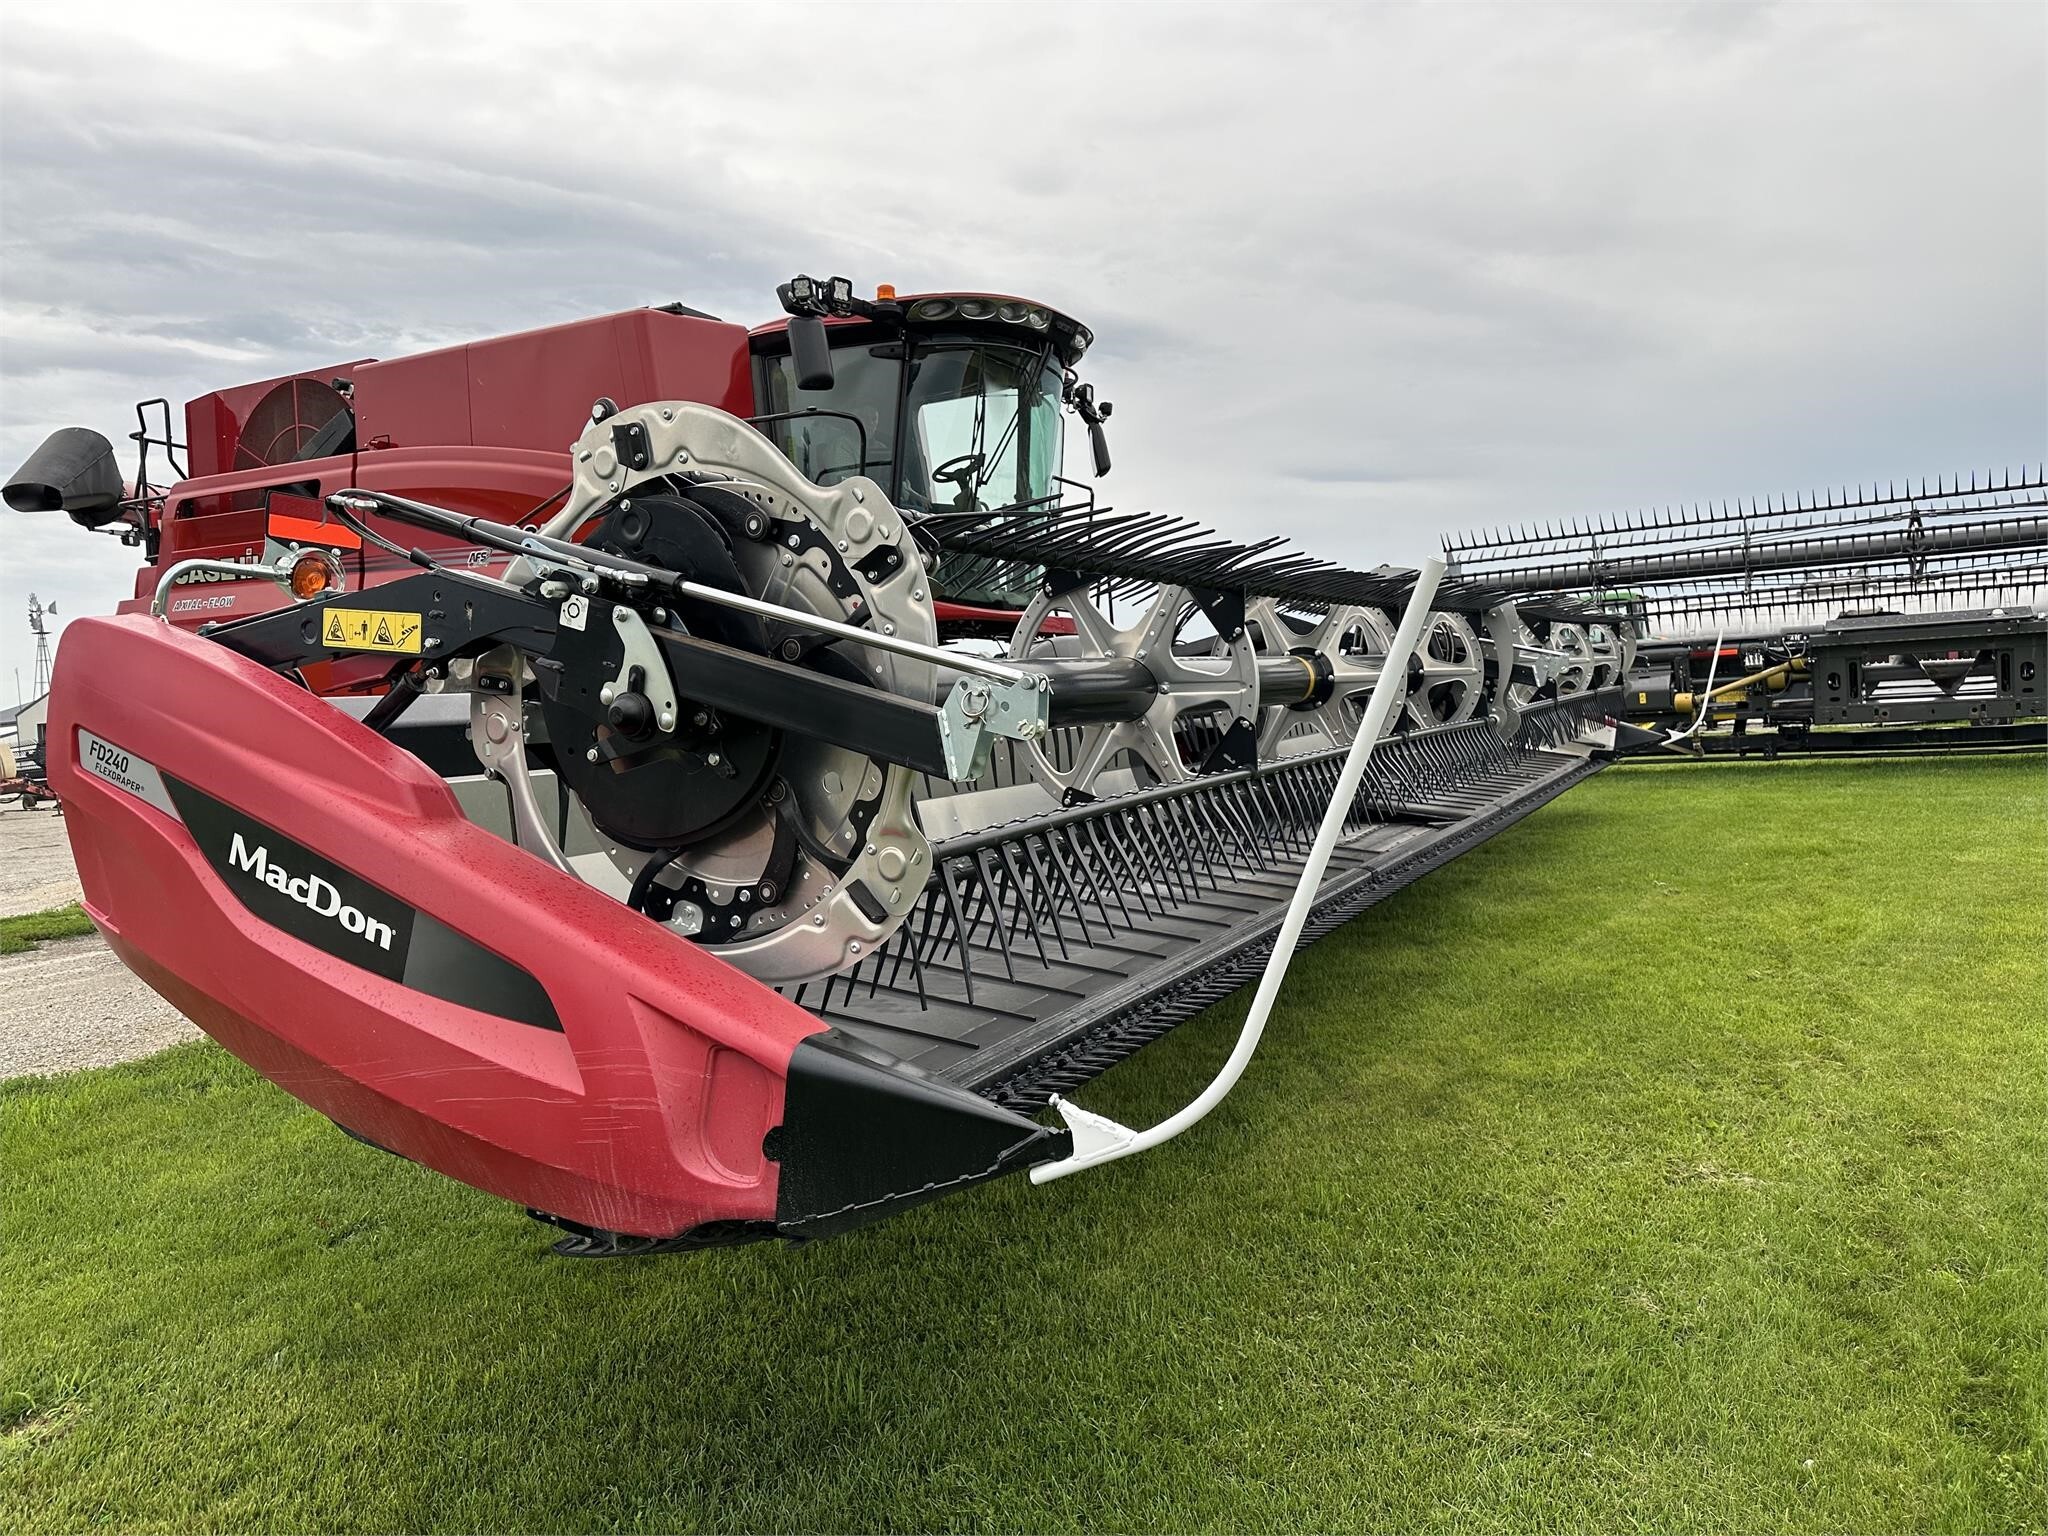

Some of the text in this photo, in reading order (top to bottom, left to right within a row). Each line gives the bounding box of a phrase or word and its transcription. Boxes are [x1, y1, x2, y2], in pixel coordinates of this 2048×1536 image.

[468, 550, 489, 563] AFS
[172, 595, 235, 612] AXIAL-FLOW
[89, 739, 129, 774] FD240
[228, 832, 393, 951] MacDon
